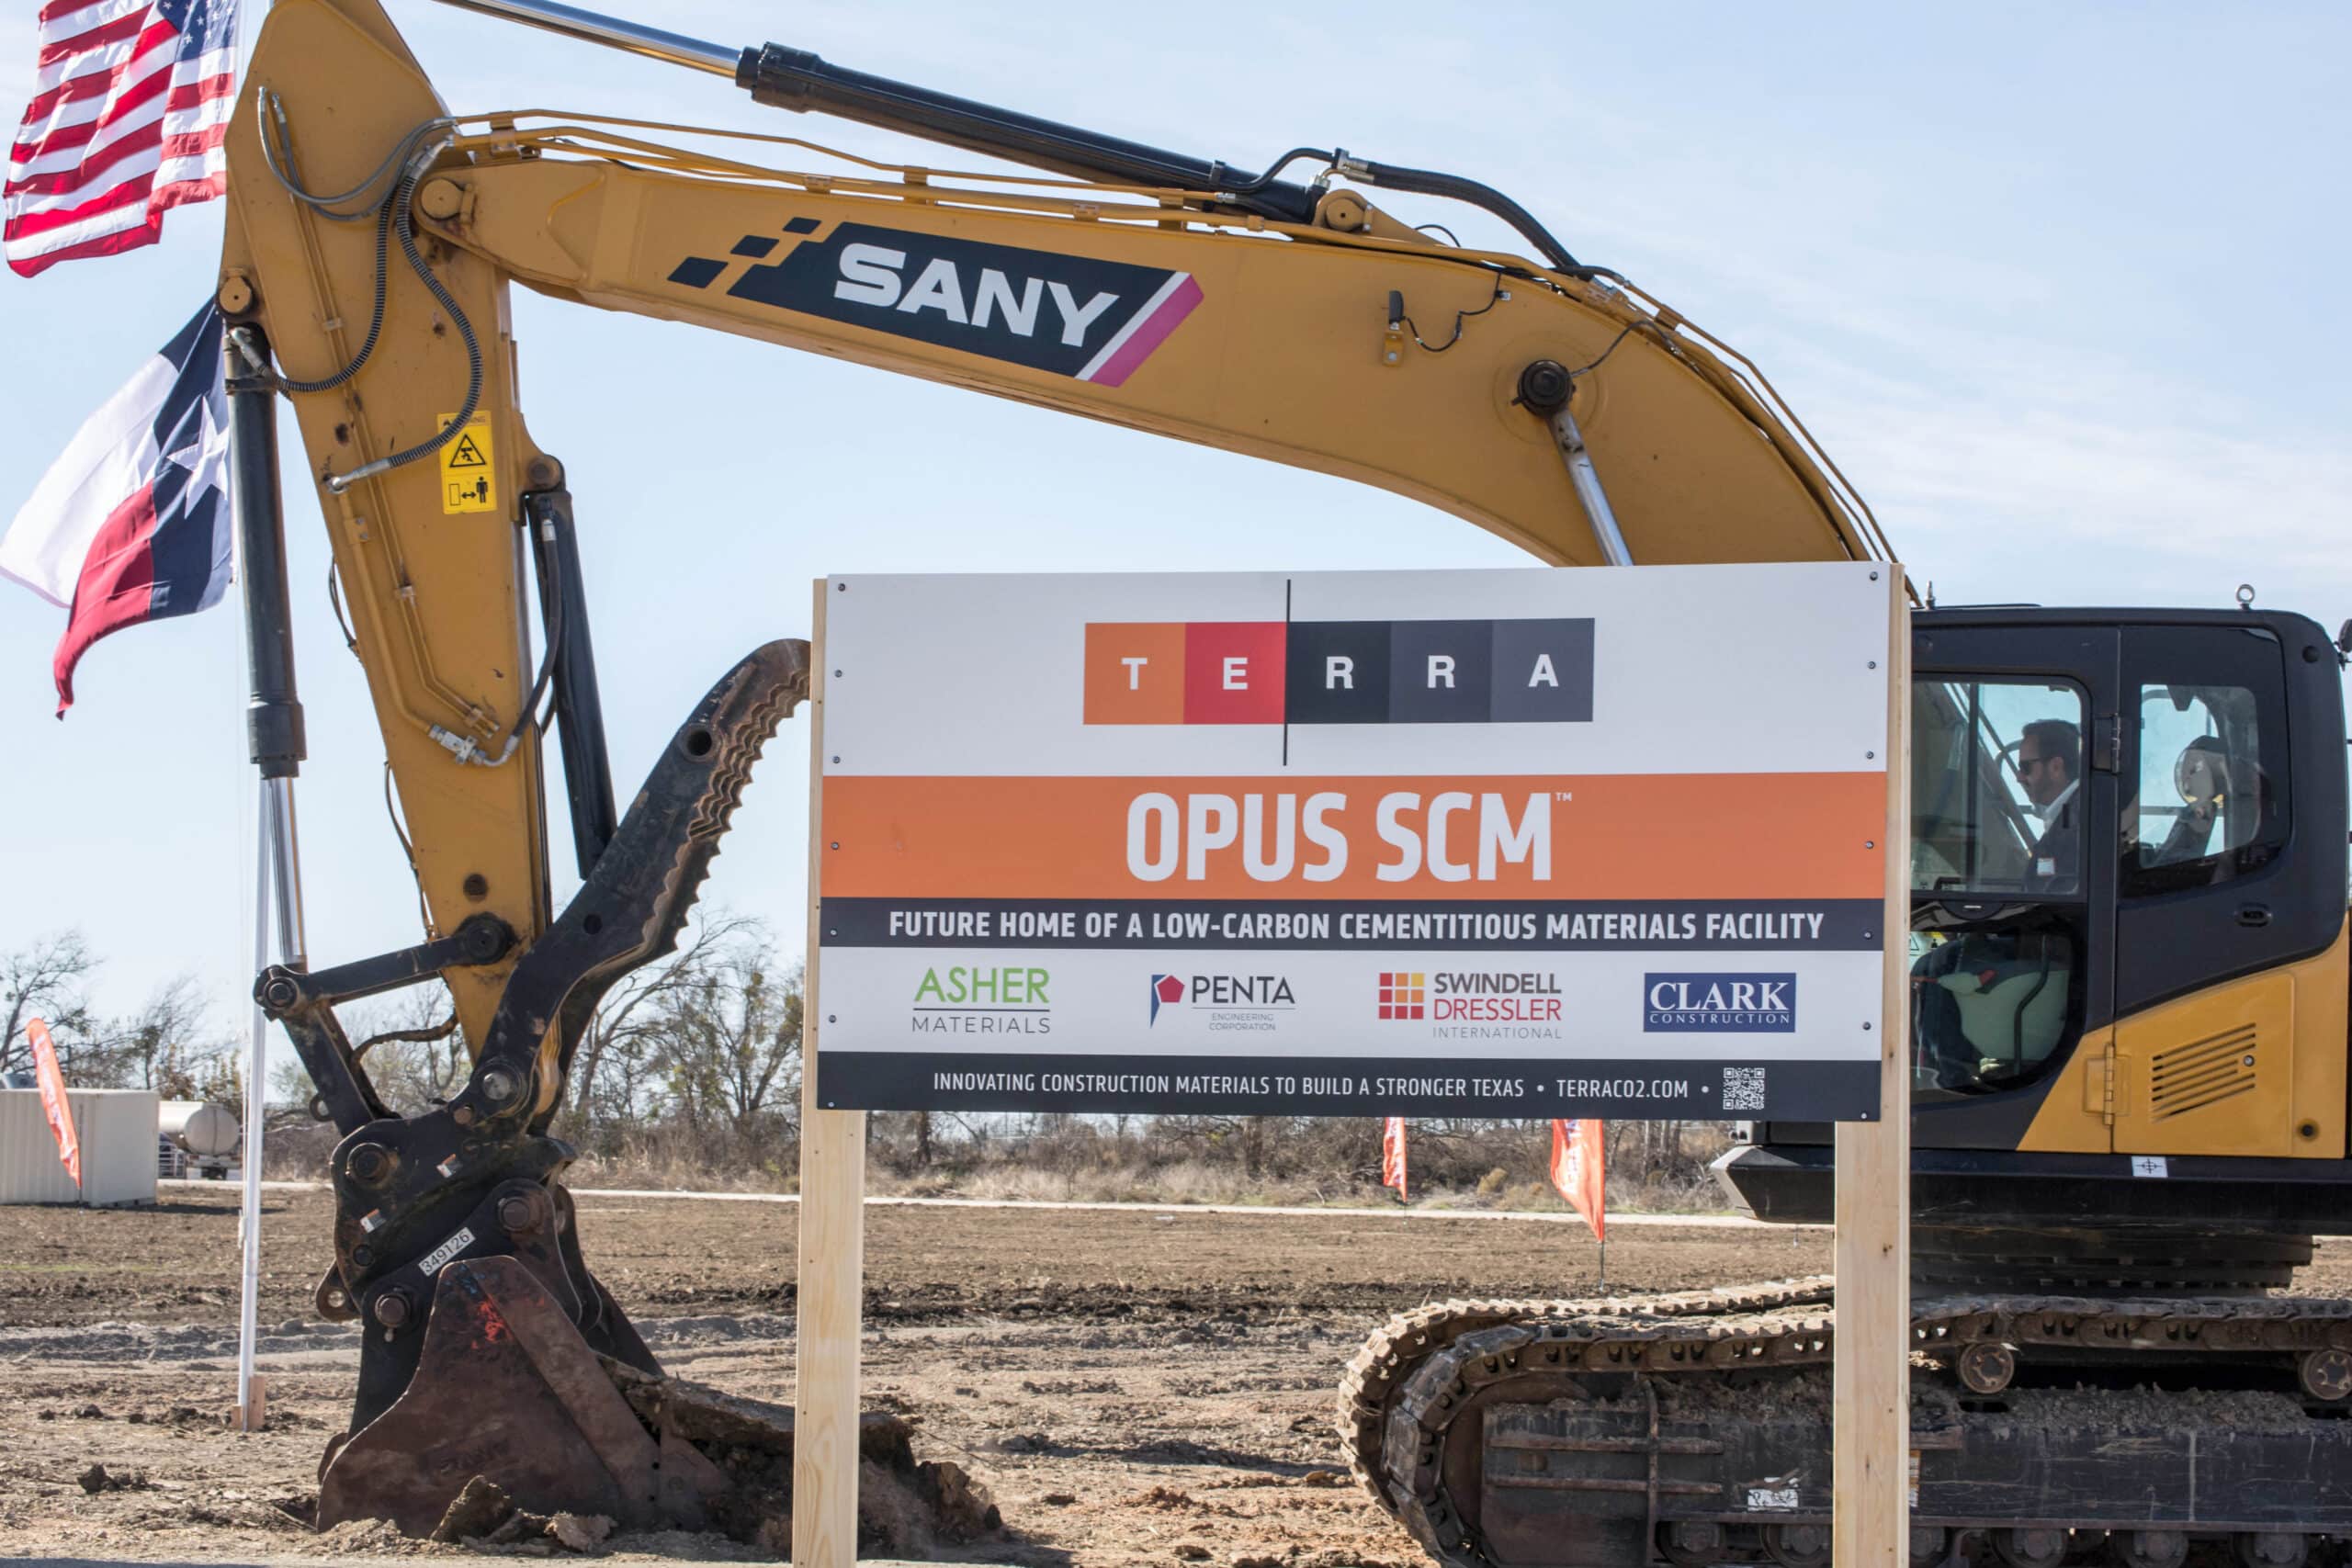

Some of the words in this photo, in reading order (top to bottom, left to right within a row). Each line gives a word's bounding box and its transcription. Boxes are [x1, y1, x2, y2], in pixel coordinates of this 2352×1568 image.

[833, 242, 1120, 347] SANY
[1121, 654, 1559, 690] TERRA
[1126, 792, 1349, 883] OPUS
[889, 910, 990, 937] FUTURE
[1000, 911, 1076, 938] HOME
[1085, 912, 1118, 938] OF
[1125, 912, 1144, 938] A
[1152, 912, 1329, 940] LOW-CARBON
[1340, 913, 1537, 940] CEMENTITIOUS
[1545, 913, 1697, 940] MATERIALS
[1705, 912, 1825, 940] FACILITY
[913, 966, 1050, 1004] ASHER
[1192, 976, 1295, 1005] PENTA
[1433, 972, 1562, 995] SWINDELL
[1650, 981, 1788, 1010] CLARK
[1211, 1012, 1274, 1021] ENGINEERING
[1433, 998, 1562, 1021] DRESSLER
[1649, 1012, 1791, 1024] CONSTRUCTION
[911, 1016, 1051, 1034] MATERIALS
[1209, 1021, 1276, 1031] CORPORATION
[1432, 1026, 1562, 1040] INTERNATIONAL
[933, 1072, 1035, 1092] INNOVATING
[1041, 1073, 1170, 1094] CONSTRUCTION
[1175, 1076, 1270, 1095] MATERIALS
[1274, 1077, 1295, 1095] TO
[1302, 1077, 1353, 1096] BUILD
[1358, 1077, 1370, 1096] A
[1375, 1077, 1466, 1097] STRONGER
[1472, 1078, 1525, 1098] TEXAS
[1555, 1079, 1689, 1099] TERRACO2.COM
[422, 1232, 469, 1272] 349126
